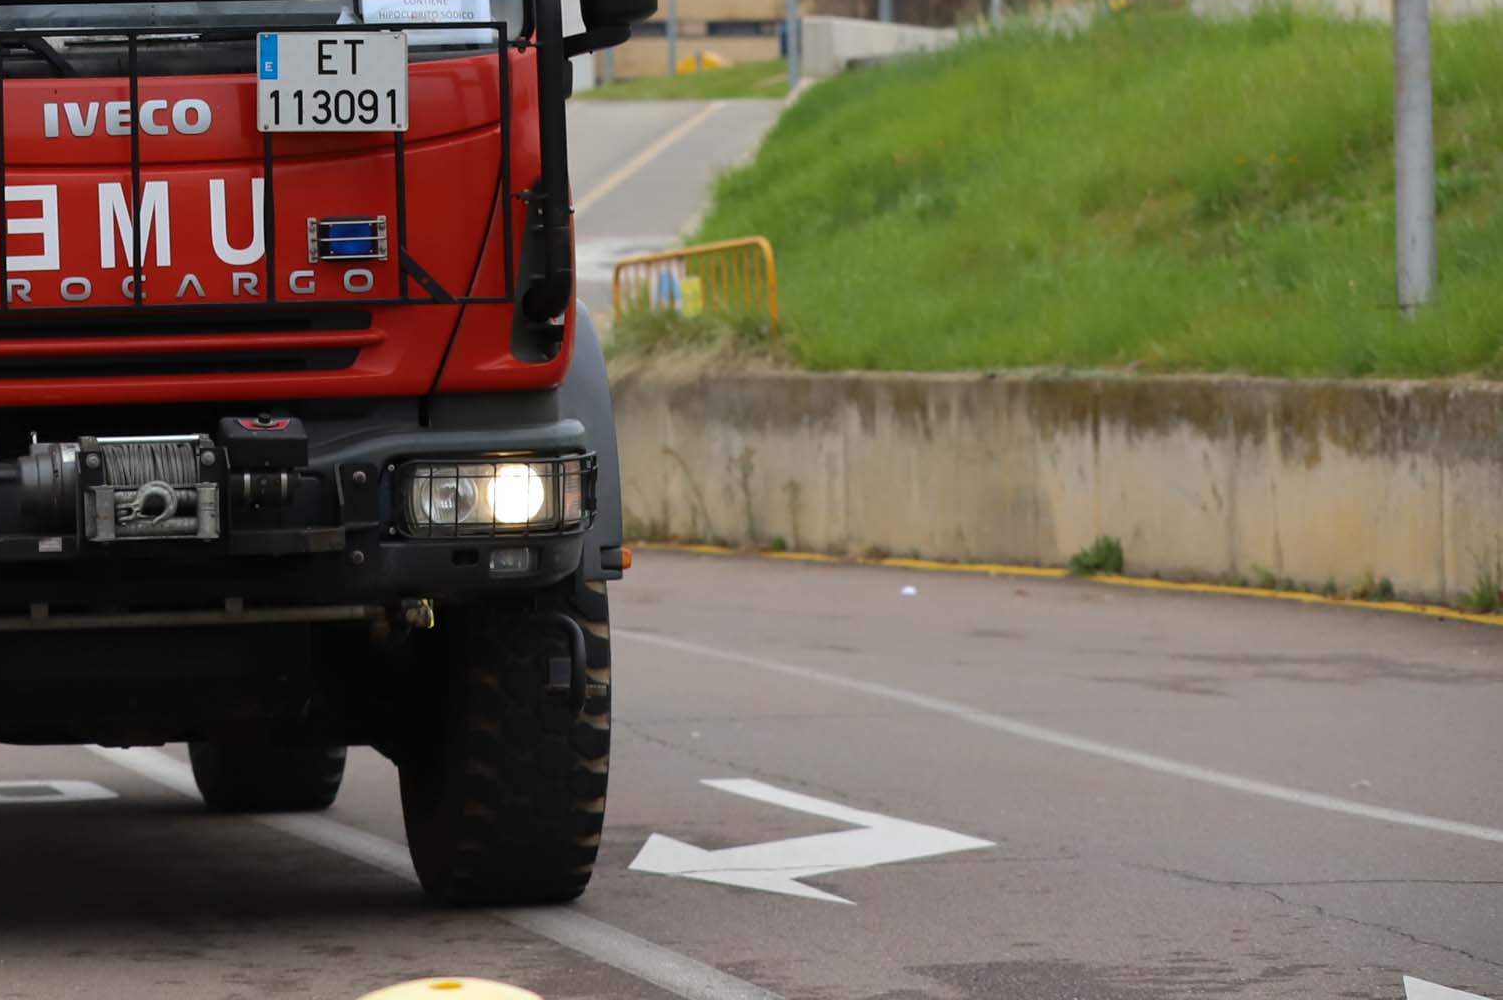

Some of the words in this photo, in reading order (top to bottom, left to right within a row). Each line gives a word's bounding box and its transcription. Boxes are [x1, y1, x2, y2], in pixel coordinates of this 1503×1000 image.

[264, 61, 274, 72] E
[318, 39, 364, 75] ET
[43, 98, 212, 138] IVECO
[269, 88, 397, 125] 113091
